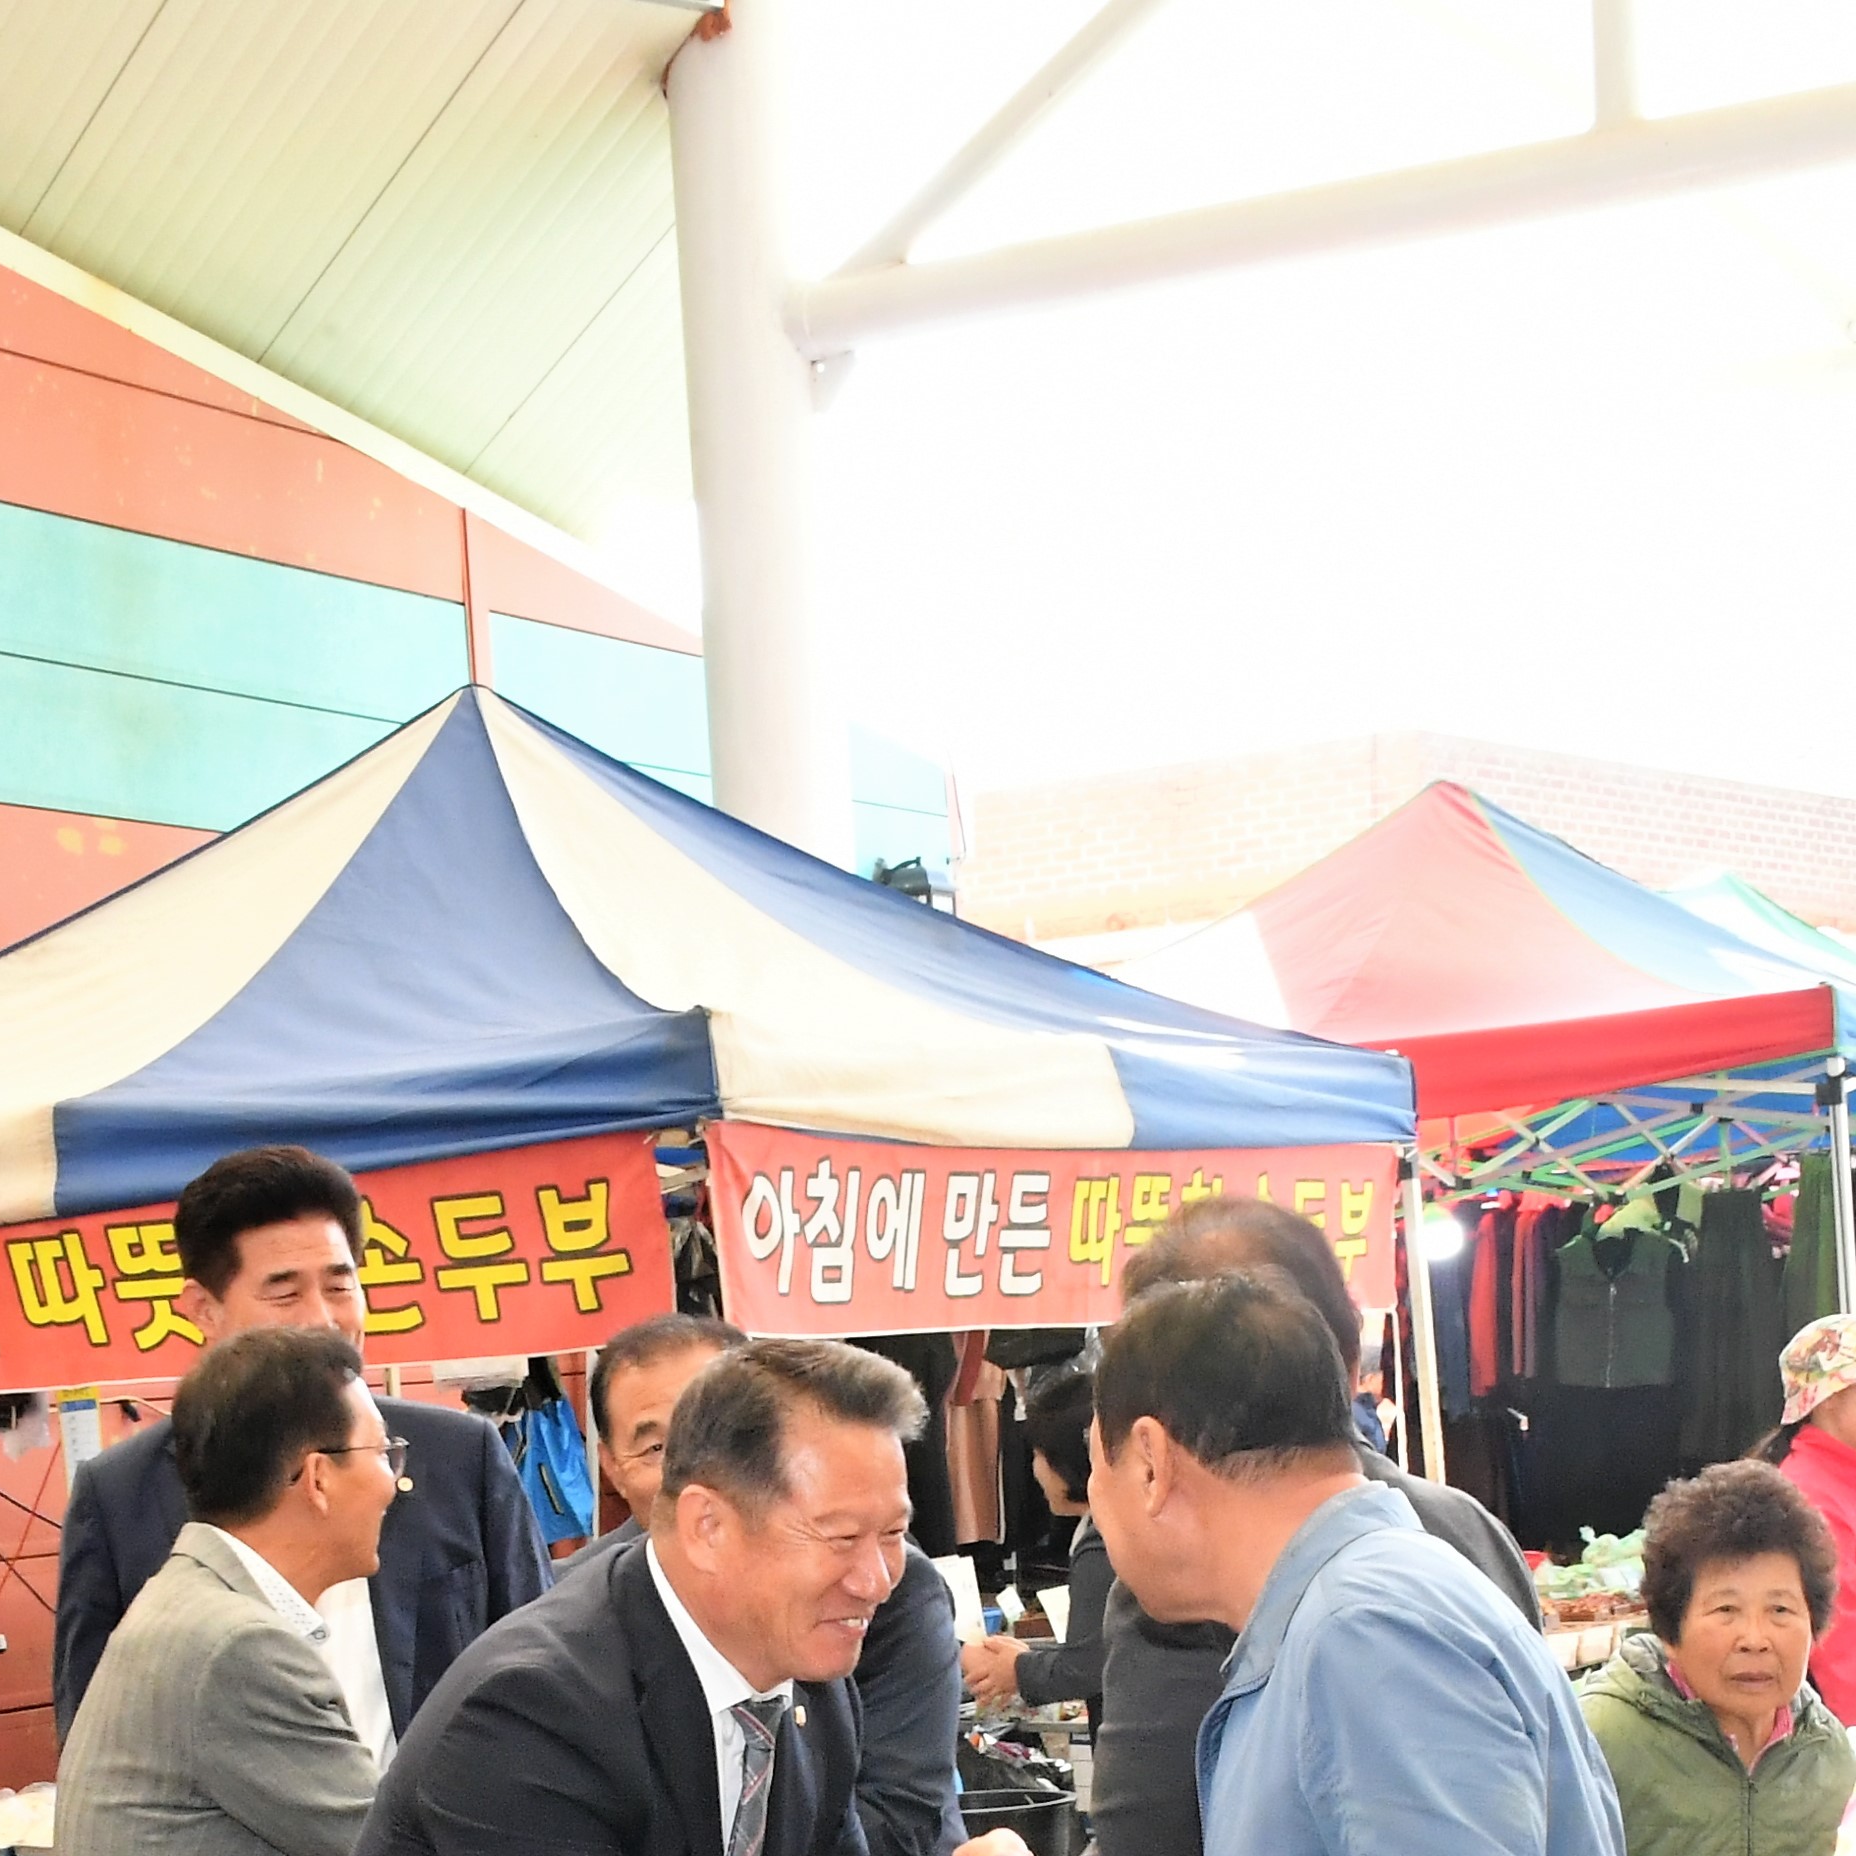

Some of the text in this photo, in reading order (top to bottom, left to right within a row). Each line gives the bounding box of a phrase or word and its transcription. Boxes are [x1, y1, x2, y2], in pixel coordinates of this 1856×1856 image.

[4, 1218, 207, 1352] 따뜻
[741, 1155, 927, 1305] 아침에
[942, 1168, 1053, 1298] 만든
